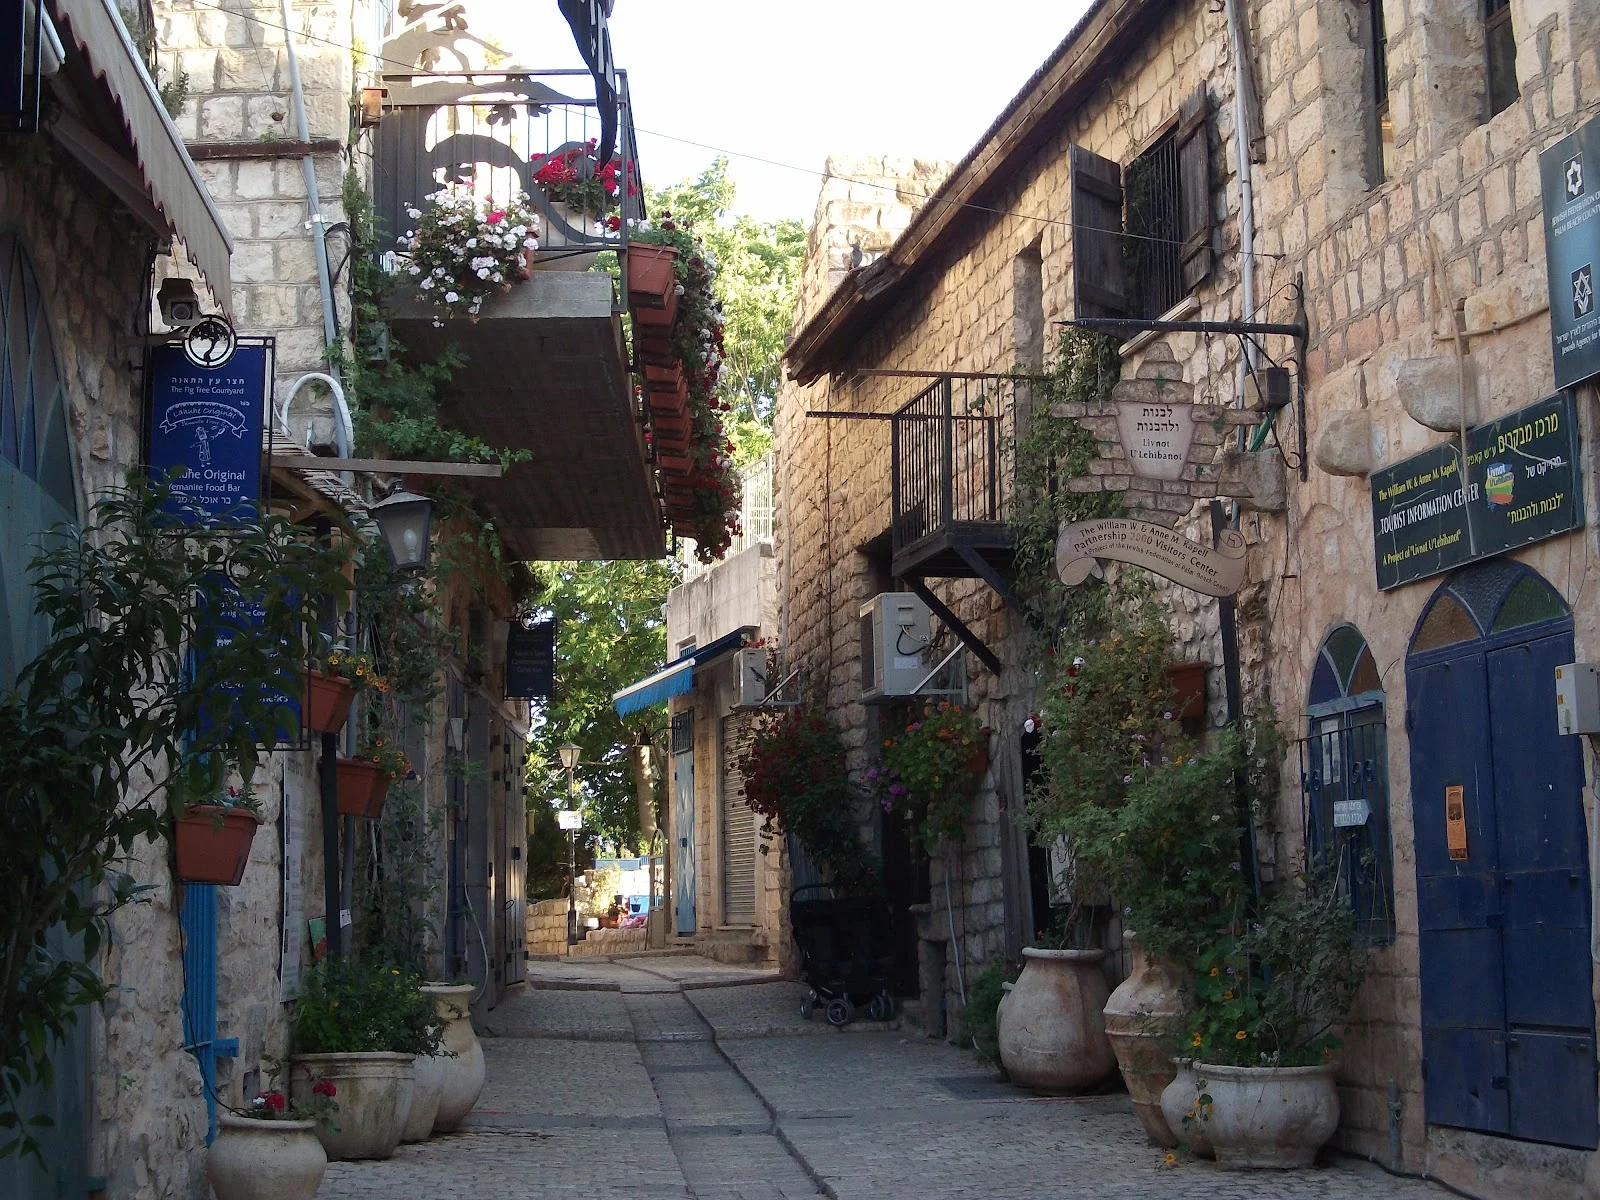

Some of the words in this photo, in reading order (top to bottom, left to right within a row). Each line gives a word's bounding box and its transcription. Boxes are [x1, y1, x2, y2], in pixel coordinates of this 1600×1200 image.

[208, 377, 221, 386] עץ
[184, 386, 194, 395] Fig
[196, 386, 210, 394] Tree
[211, 386, 244, 396] Courtyard
[202, 407, 237, 419] Original
[1142, 404, 1173, 418] לבנות
[1136, 419, 1180, 432] ולהבנות
[1535, 412, 1559, 439] מרכז
[1142, 438, 1170, 448] Livnot
[1497, 422, 1533, 453] מבקרים
[1130, 449, 1182, 461] U'Lehibanot
[204, 468, 246, 483] Original
[1525, 464, 1536, 479] של
[1378, 489, 1388, 501] The
[1387, 482, 1407, 498] William
[1406, 477, 1414, 490] W.
[1413, 475, 1418, 488] &
[1419, 472, 1432, 485] Anne
[1432, 467, 1440, 480] M.
[1440, 459, 1457, 479] Kapell
[205, 483, 226, 492] Food
[227, 483, 241, 492] Bar
[199, 494, 219, 504] אוכל
[221, 496, 232, 504] בר
[1379, 509, 1406, 535] TOURIST
[1406, 490, 1453, 526] INFORMATION
[1079, 526, 1096, 538] The
[1096, 521, 1127, 532] William
[1129, 521, 1138, 531] W.
[1140, 524, 1148, 533] &
[1149, 526, 1170, 540] Anne
[1170, 534, 1181, 545] M.
[1182, 540, 1209, 558] Kapell
[1115, 541, 1125, 549] the
[1073, 530, 1127, 553] Partnership
[1130, 531, 1153, 545] 2000
[1190, 556, 1218, 577] Center
[1382, 552, 1388, 567] A
[1387, 548, 1405, 565] Project
[1404, 546, 1411, 559] of
